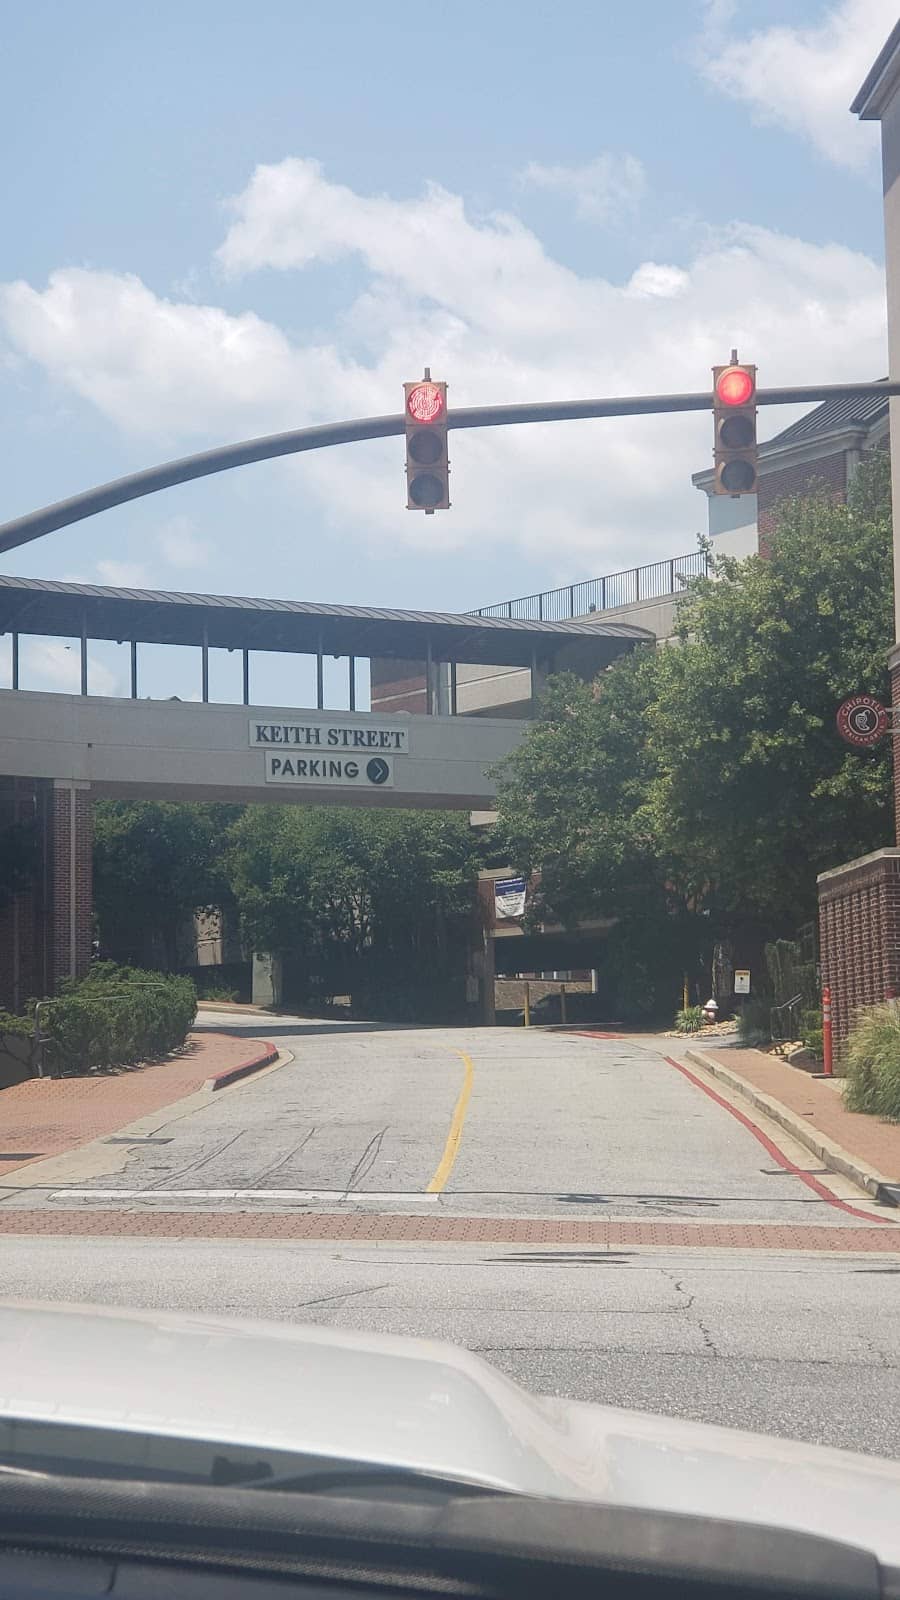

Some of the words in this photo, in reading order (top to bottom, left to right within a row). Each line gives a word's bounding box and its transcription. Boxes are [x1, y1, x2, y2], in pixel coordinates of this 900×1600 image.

[841, 697, 886, 716] CHIPOTLE
[255, 725, 321, 745] KEITH
[327, 728, 405, 748] STREET
[271, 758, 360, 778] PARKING
